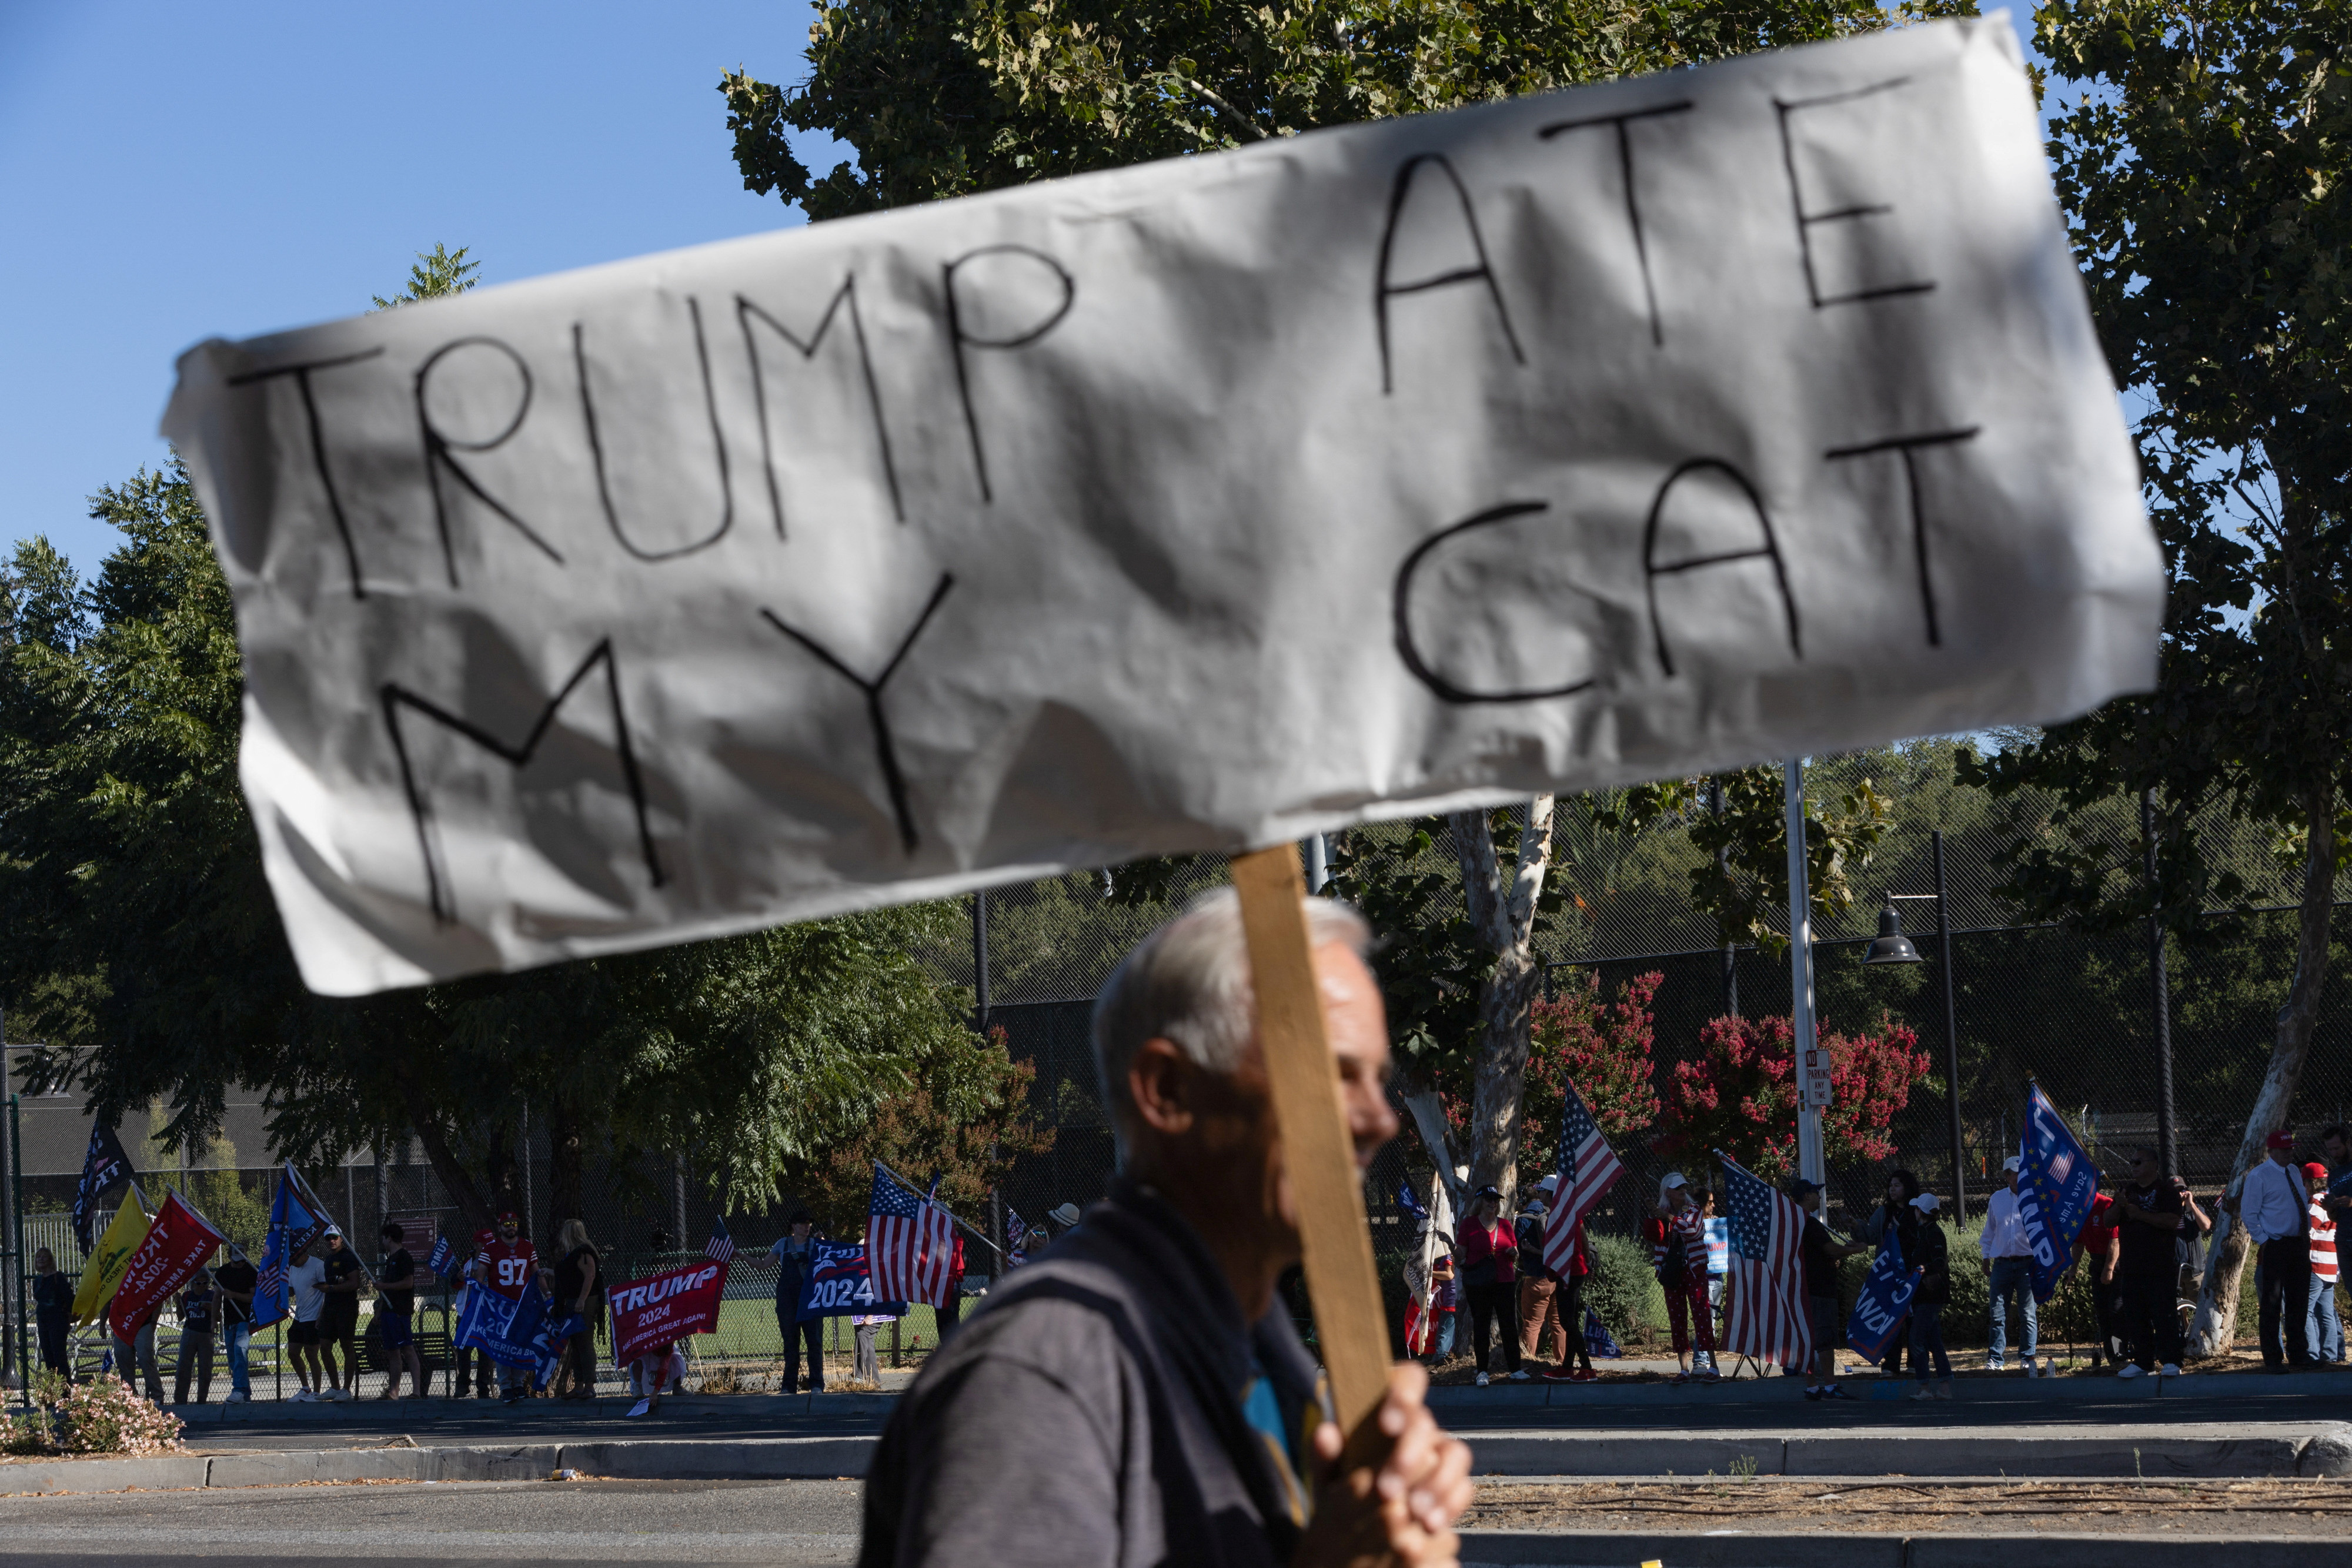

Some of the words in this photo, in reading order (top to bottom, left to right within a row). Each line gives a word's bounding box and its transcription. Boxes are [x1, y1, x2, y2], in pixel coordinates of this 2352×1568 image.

[228, 244, 1075, 601] TRUMP
[1374, 75, 1937, 396] ATE
[381, 571, 954, 927] MY
[1392, 426, 1981, 704] CAT
[1808, 1052, 1816, 1065] NO
[1808, 1069, 1829, 1079] PARKING
[1815, 1091, 1826, 1099] TIME
[1706, 1241, 1726, 1252] UMP
[498, 1259, 527, 1286] 97
[1405, 1267, 1423, 1292] 2024
[612, 1265, 718, 1316] TRUMP
[808, 1278, 876, 1309] 2024
[486, 1318, 506, 1335] 20
[638, 1303, 671, 1328] 2024
[632, 1328, 657, 1345] AMERICA
[658, 1319, 681, 1333] GREAT
[683, 1313, 706, 1325] AGAIN!
[487, 1338, 522, 1356] MERICA
